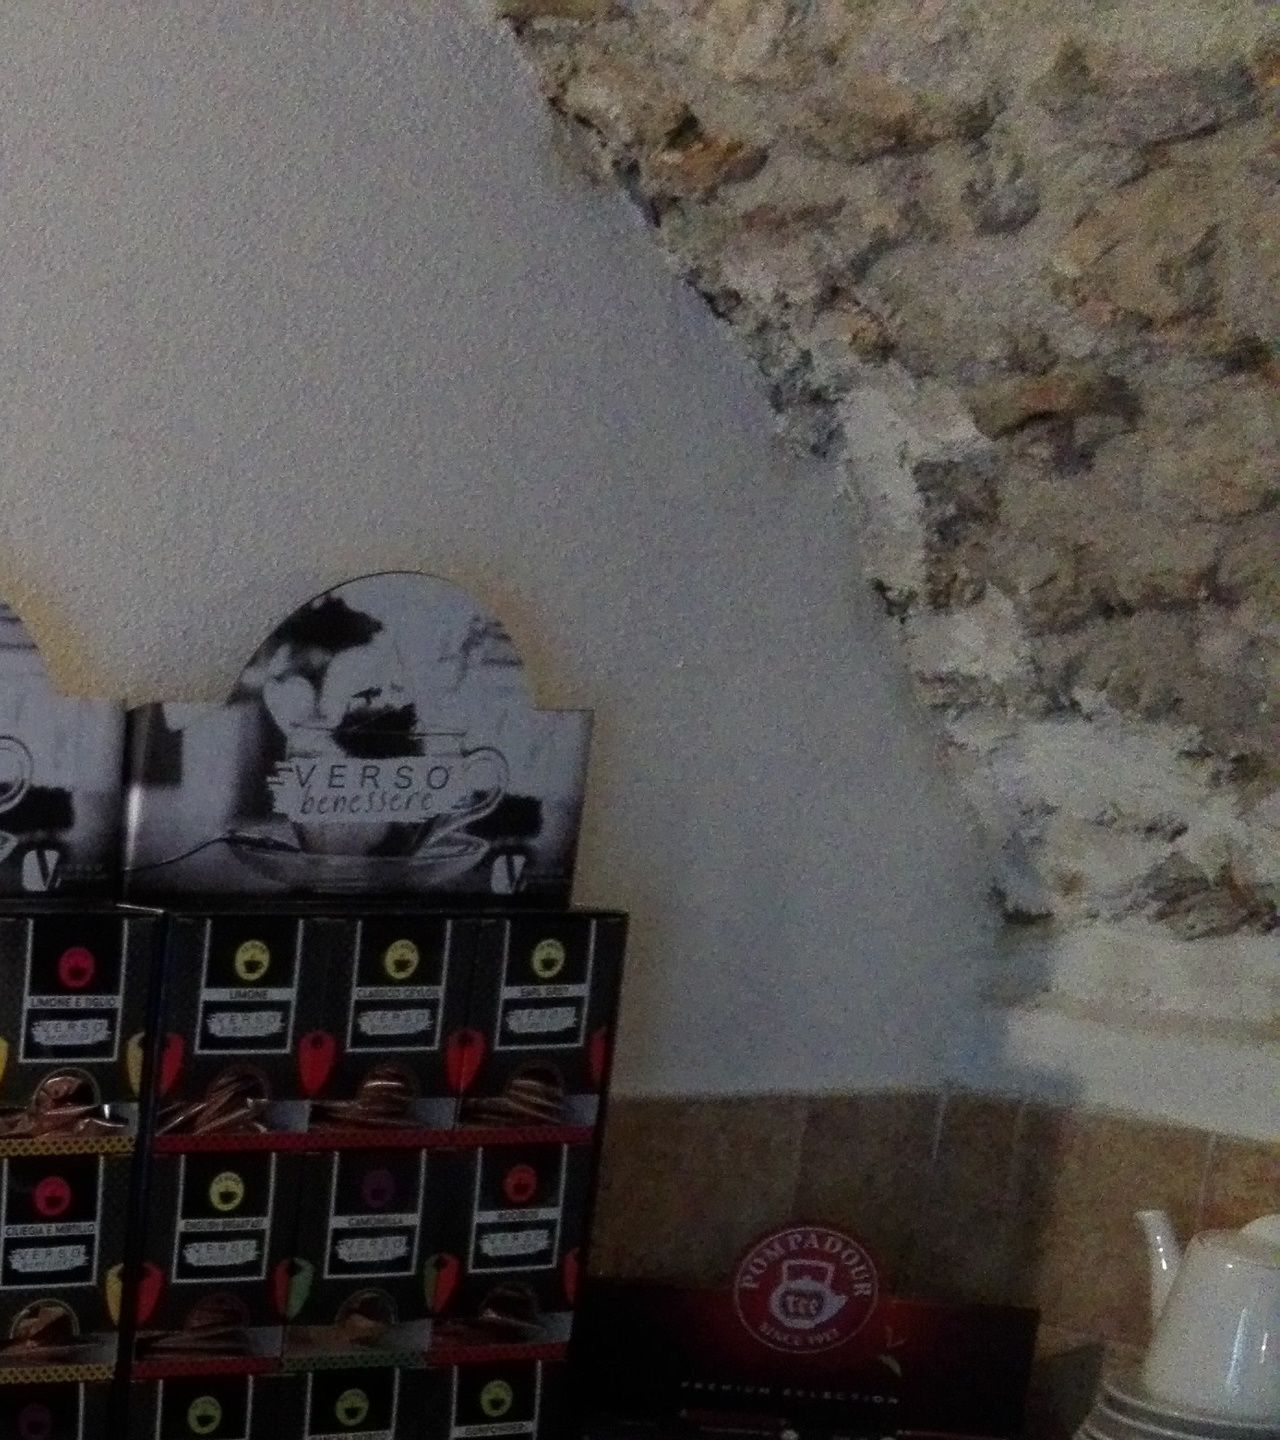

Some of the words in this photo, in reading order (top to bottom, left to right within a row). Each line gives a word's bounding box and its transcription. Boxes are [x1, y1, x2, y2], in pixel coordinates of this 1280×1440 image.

[294, 764, 452, 790] VERSO
[299, 785, 439, 815] benessere
[30, 997, 71, 1008] LIMONE
[228, 990, 269, 1000] LIMONE
[740, 1232, 874, 1298] POMPADOUR
[679, 1380, 771, 1396] PREMIUM
[781, 1386, 901, 1405] SELECTION
